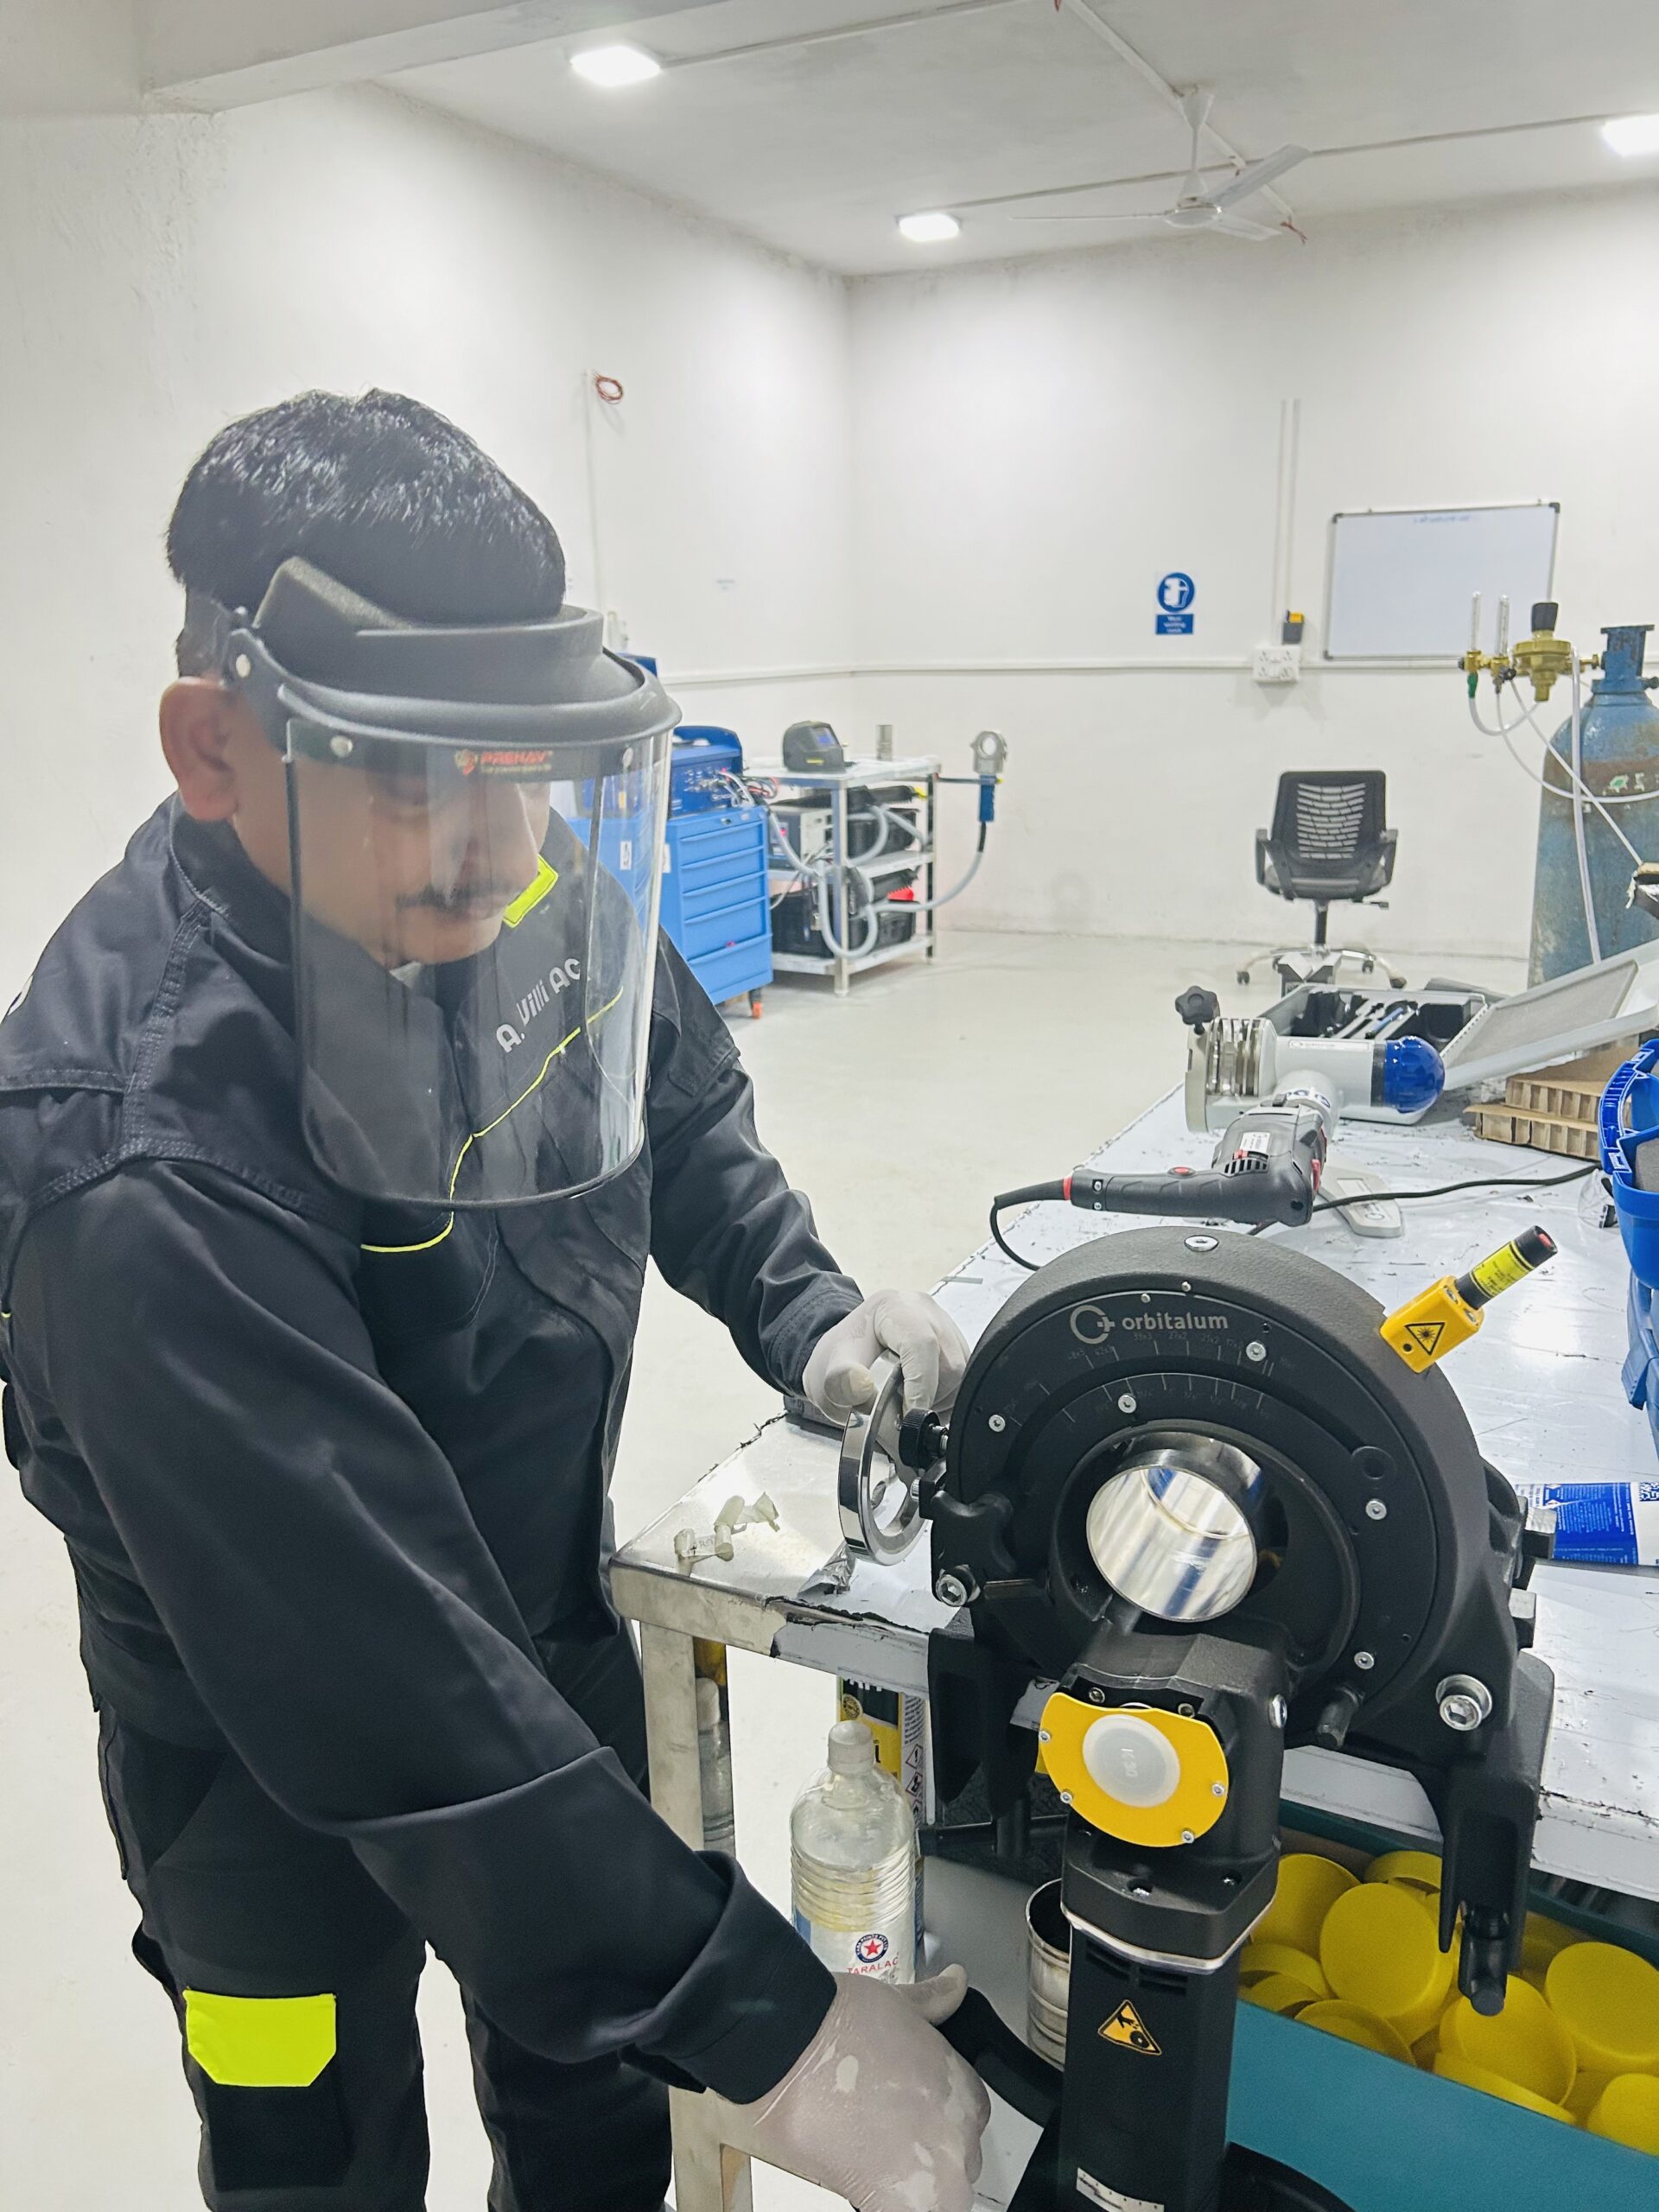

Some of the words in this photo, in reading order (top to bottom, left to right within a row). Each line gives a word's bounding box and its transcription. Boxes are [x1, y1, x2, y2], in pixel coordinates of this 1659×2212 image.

[496, 1023, 525, 1053] A.
[516, 979, 550, 1027] Villi
[1122, 1312, 1229, 1330] orbitalum
